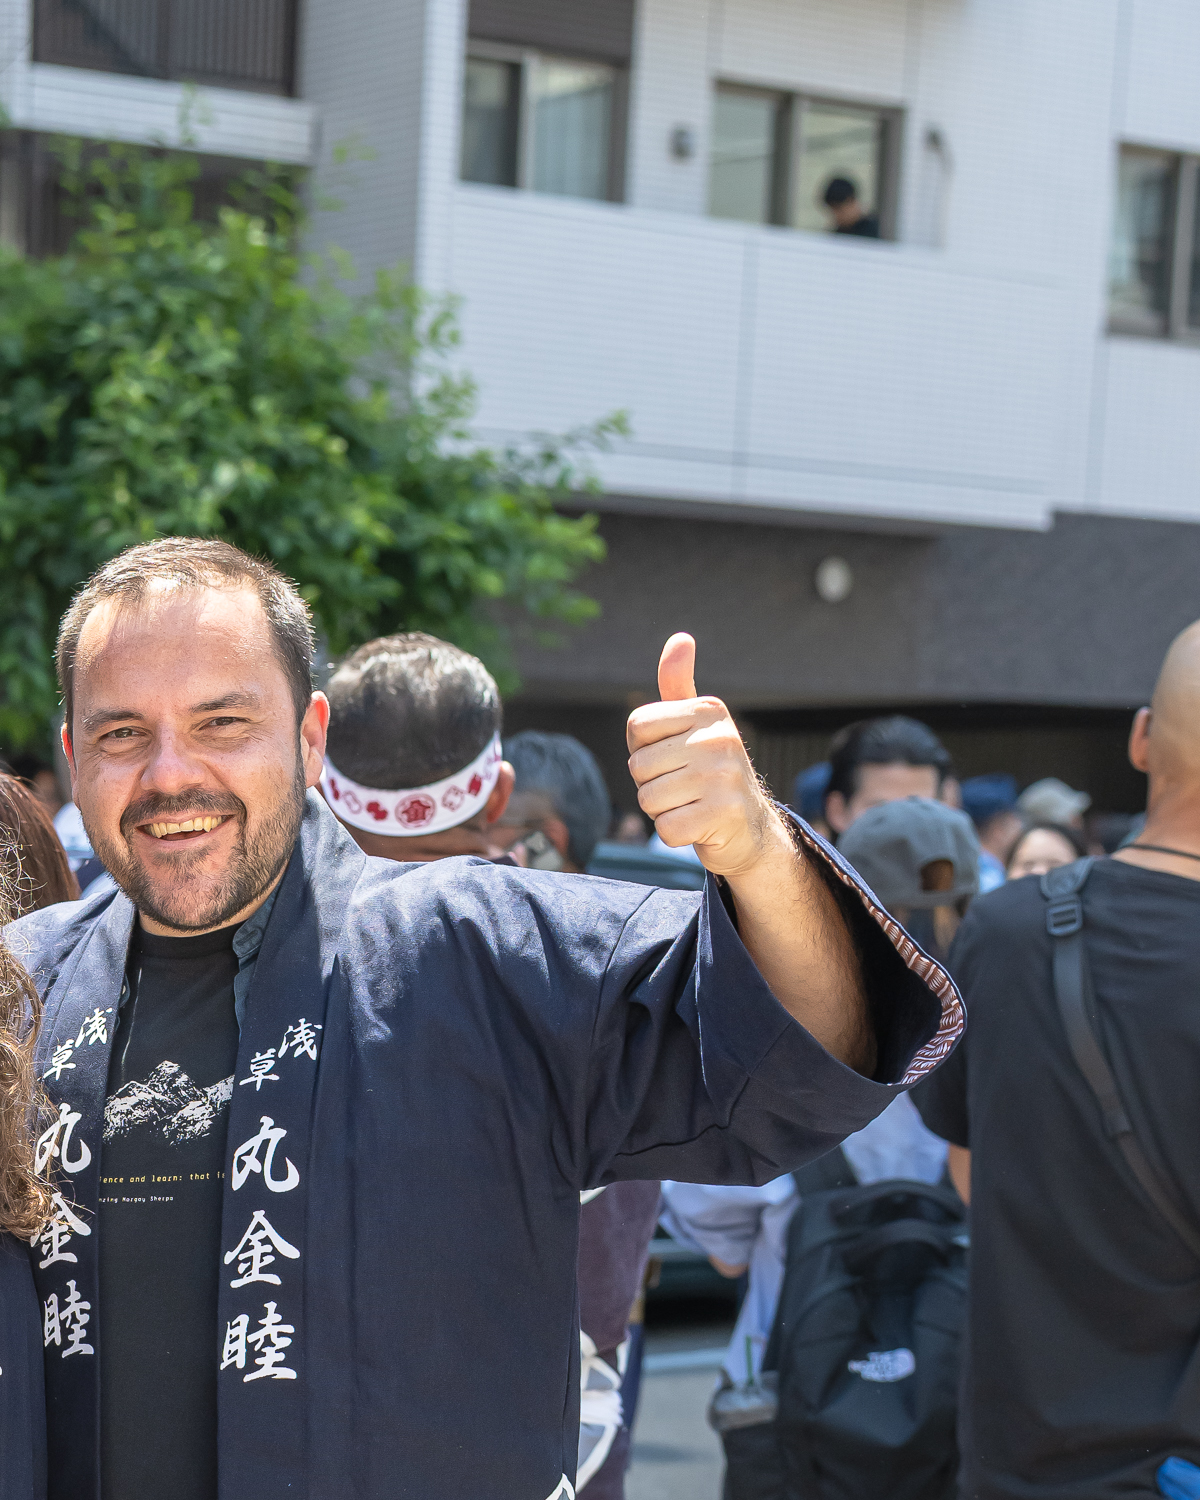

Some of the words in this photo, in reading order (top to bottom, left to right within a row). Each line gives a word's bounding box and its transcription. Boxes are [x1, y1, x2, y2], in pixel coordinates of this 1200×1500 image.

[129, 1175, 146, 1183] and
[152, 1174, 182, 1183] learn:
[189, 1172, 210, 1181] that
[150, 1195, 174, 1203] Sherpa
